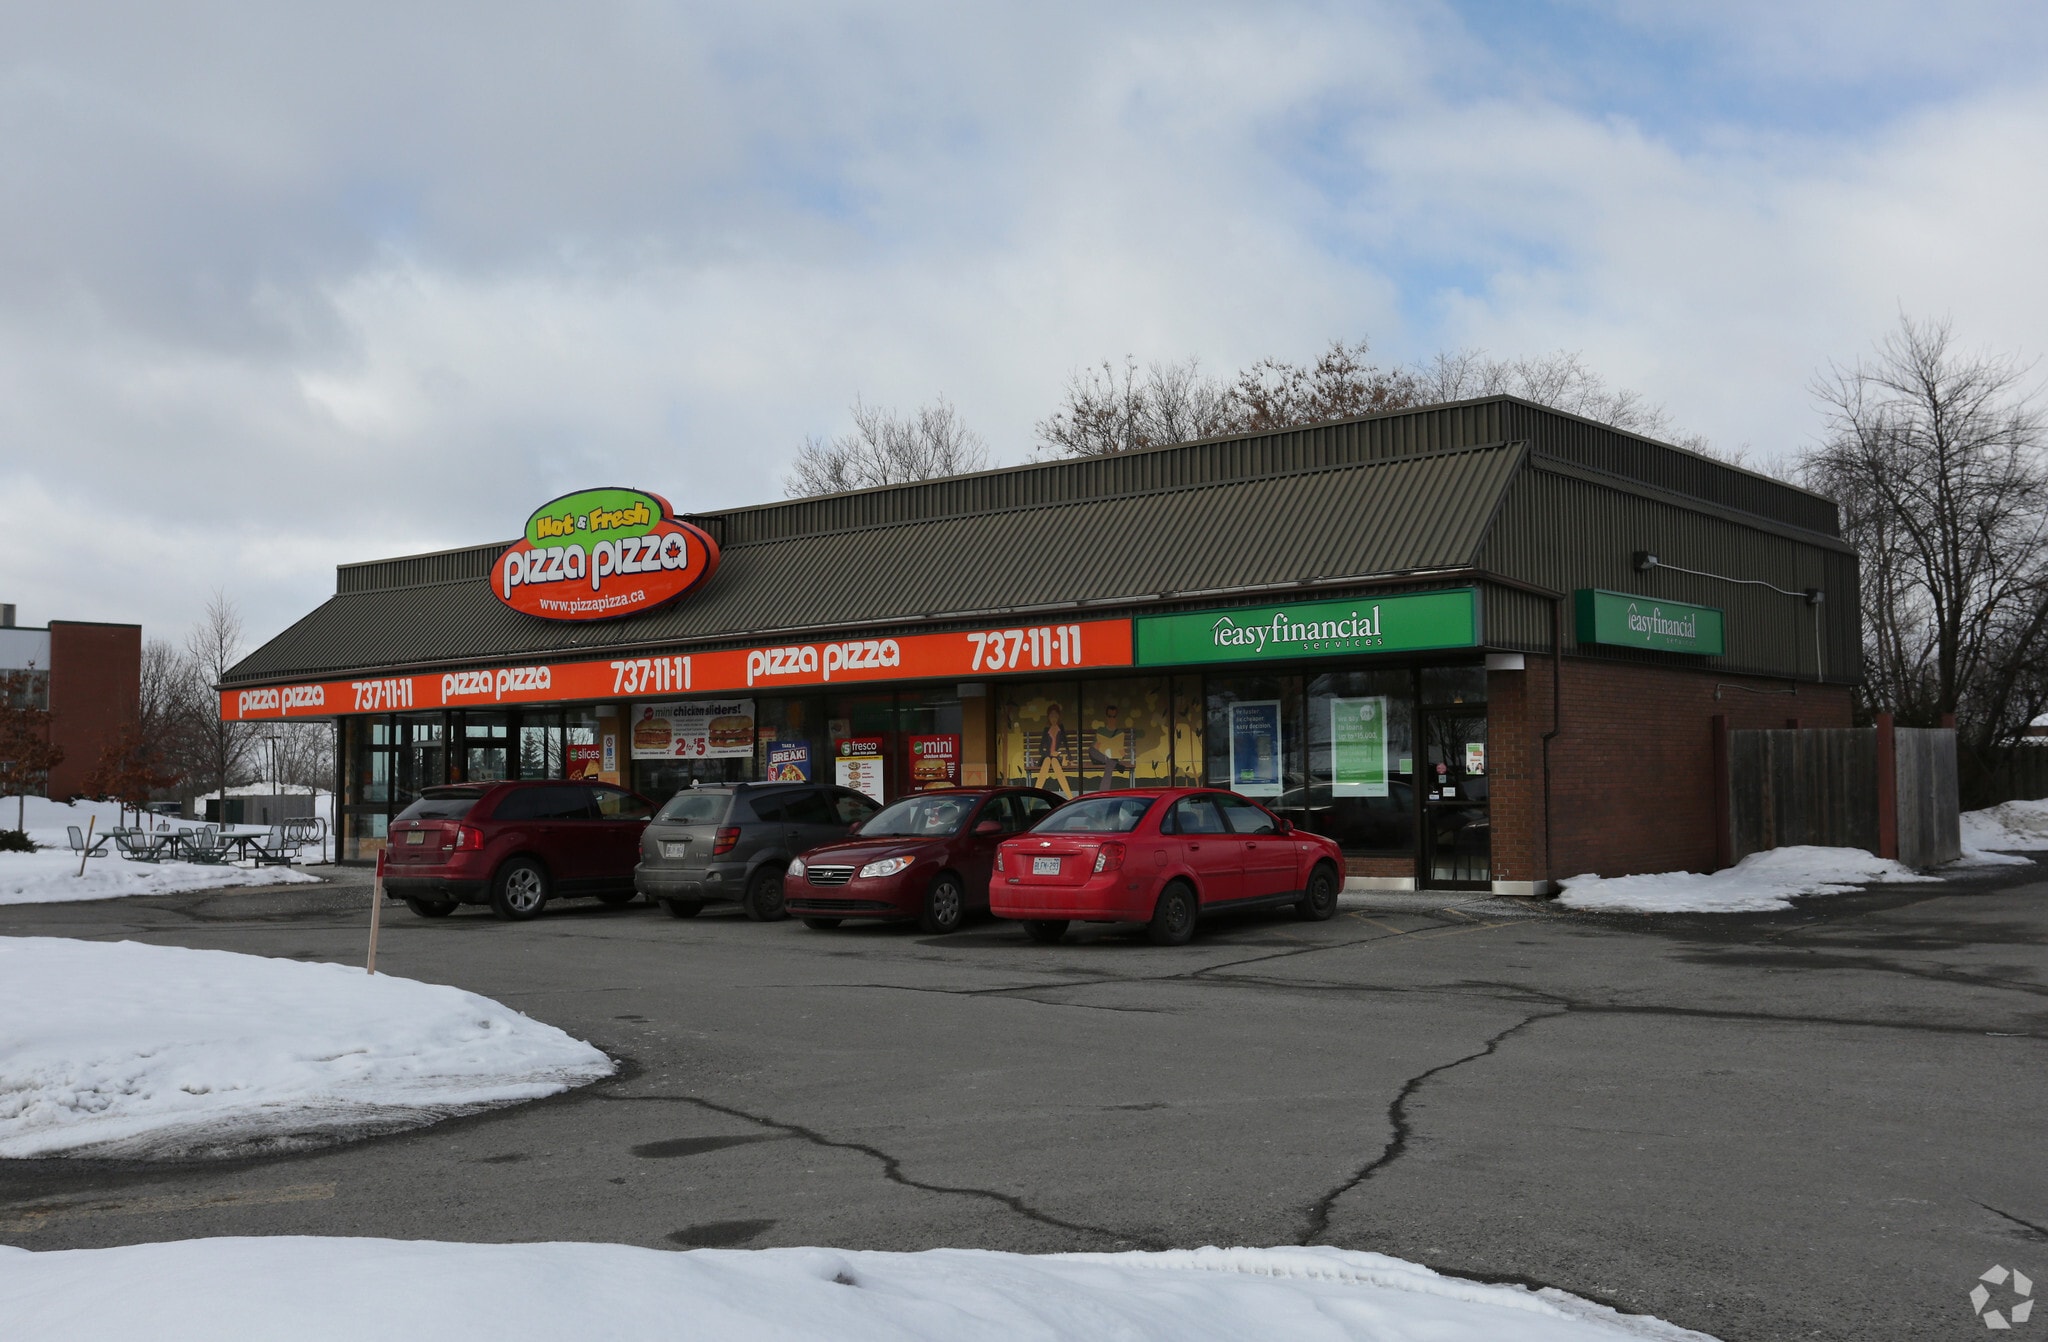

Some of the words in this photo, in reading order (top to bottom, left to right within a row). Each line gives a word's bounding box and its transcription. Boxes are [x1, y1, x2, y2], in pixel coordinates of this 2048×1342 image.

[536, 512, 575, 540] Hot
[576, 515, 588, 530] &
[589, 501, 650, 533] Fresh
[503, 544, 586, 599] pizza
[591, 532, 687, 591] pizza
[540, 589, 646, 614] www.pizzapizza.ca
[1217, 604, 1382, 653] easyfinancial
[1630, 607, 1696, 640] easyfinancial
[1303, 638, 1384, 650] services
[238, 689, 279, 718] pizza
[281, 685, 325, 716] pizza
[441, 670, 493, 704] pizza
[496, 666, 551, 701] pizza
[747, 645, 818, 687] pizza
[823, 639, 900, 681] pizza
[655, 706, 673, 717] mini
[673, 705, 704, 717] chicken
[705, 703, 741, 716] sliders!
[578, 748, 600, 759] slices
[675, 738, 686, 756] 2
[852, 741, 877, 751] fresco
[923, 737, 952, 753] mini
[772, 749, 806, 762] BREAK!
